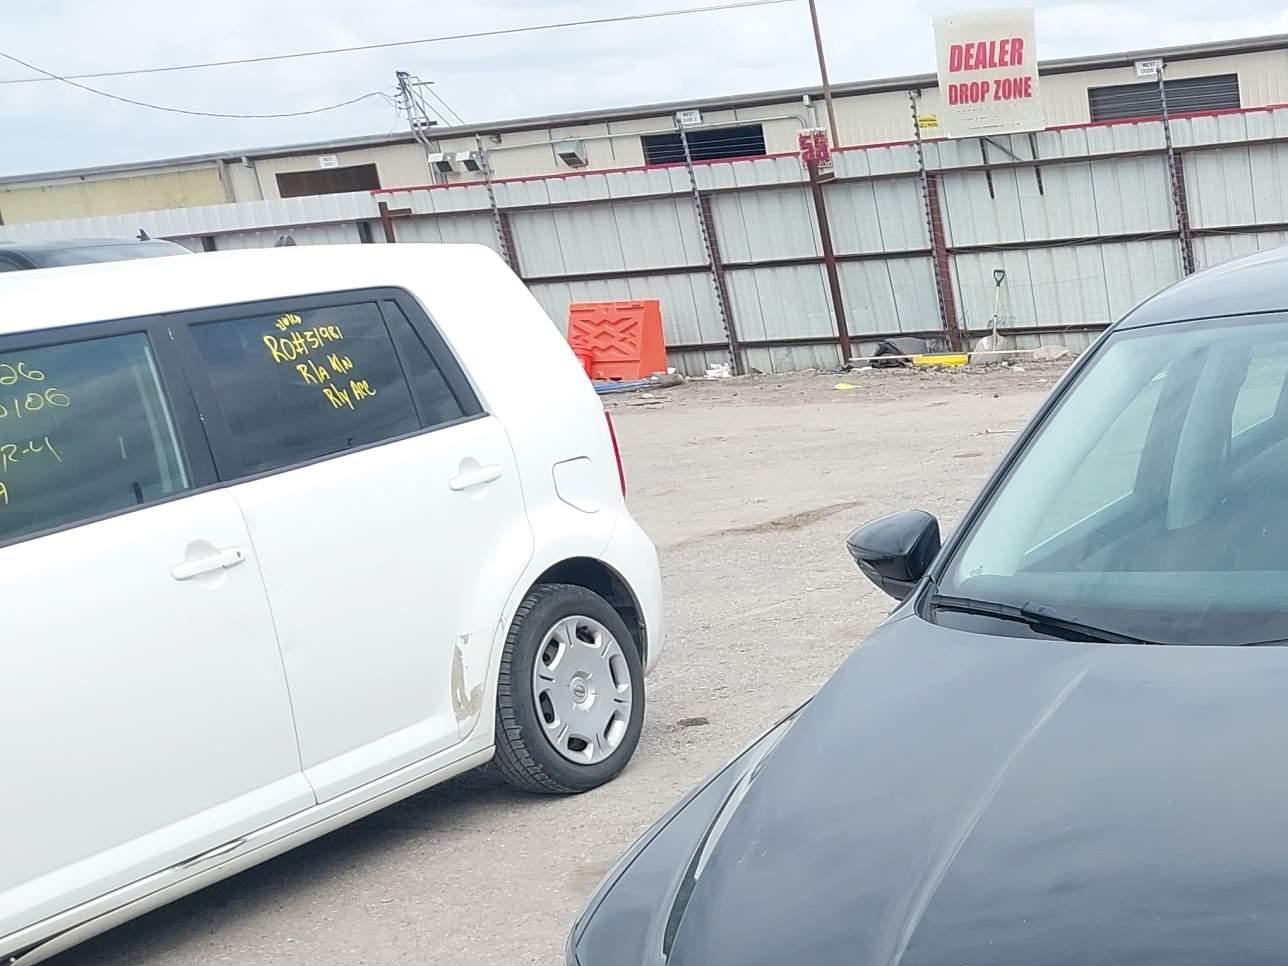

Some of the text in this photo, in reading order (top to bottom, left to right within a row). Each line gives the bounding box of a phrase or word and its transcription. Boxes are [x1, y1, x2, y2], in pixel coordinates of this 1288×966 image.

[949, 38, 1024, 73] DEALER
[948, 77, 1032, 105] DROP ZONE
